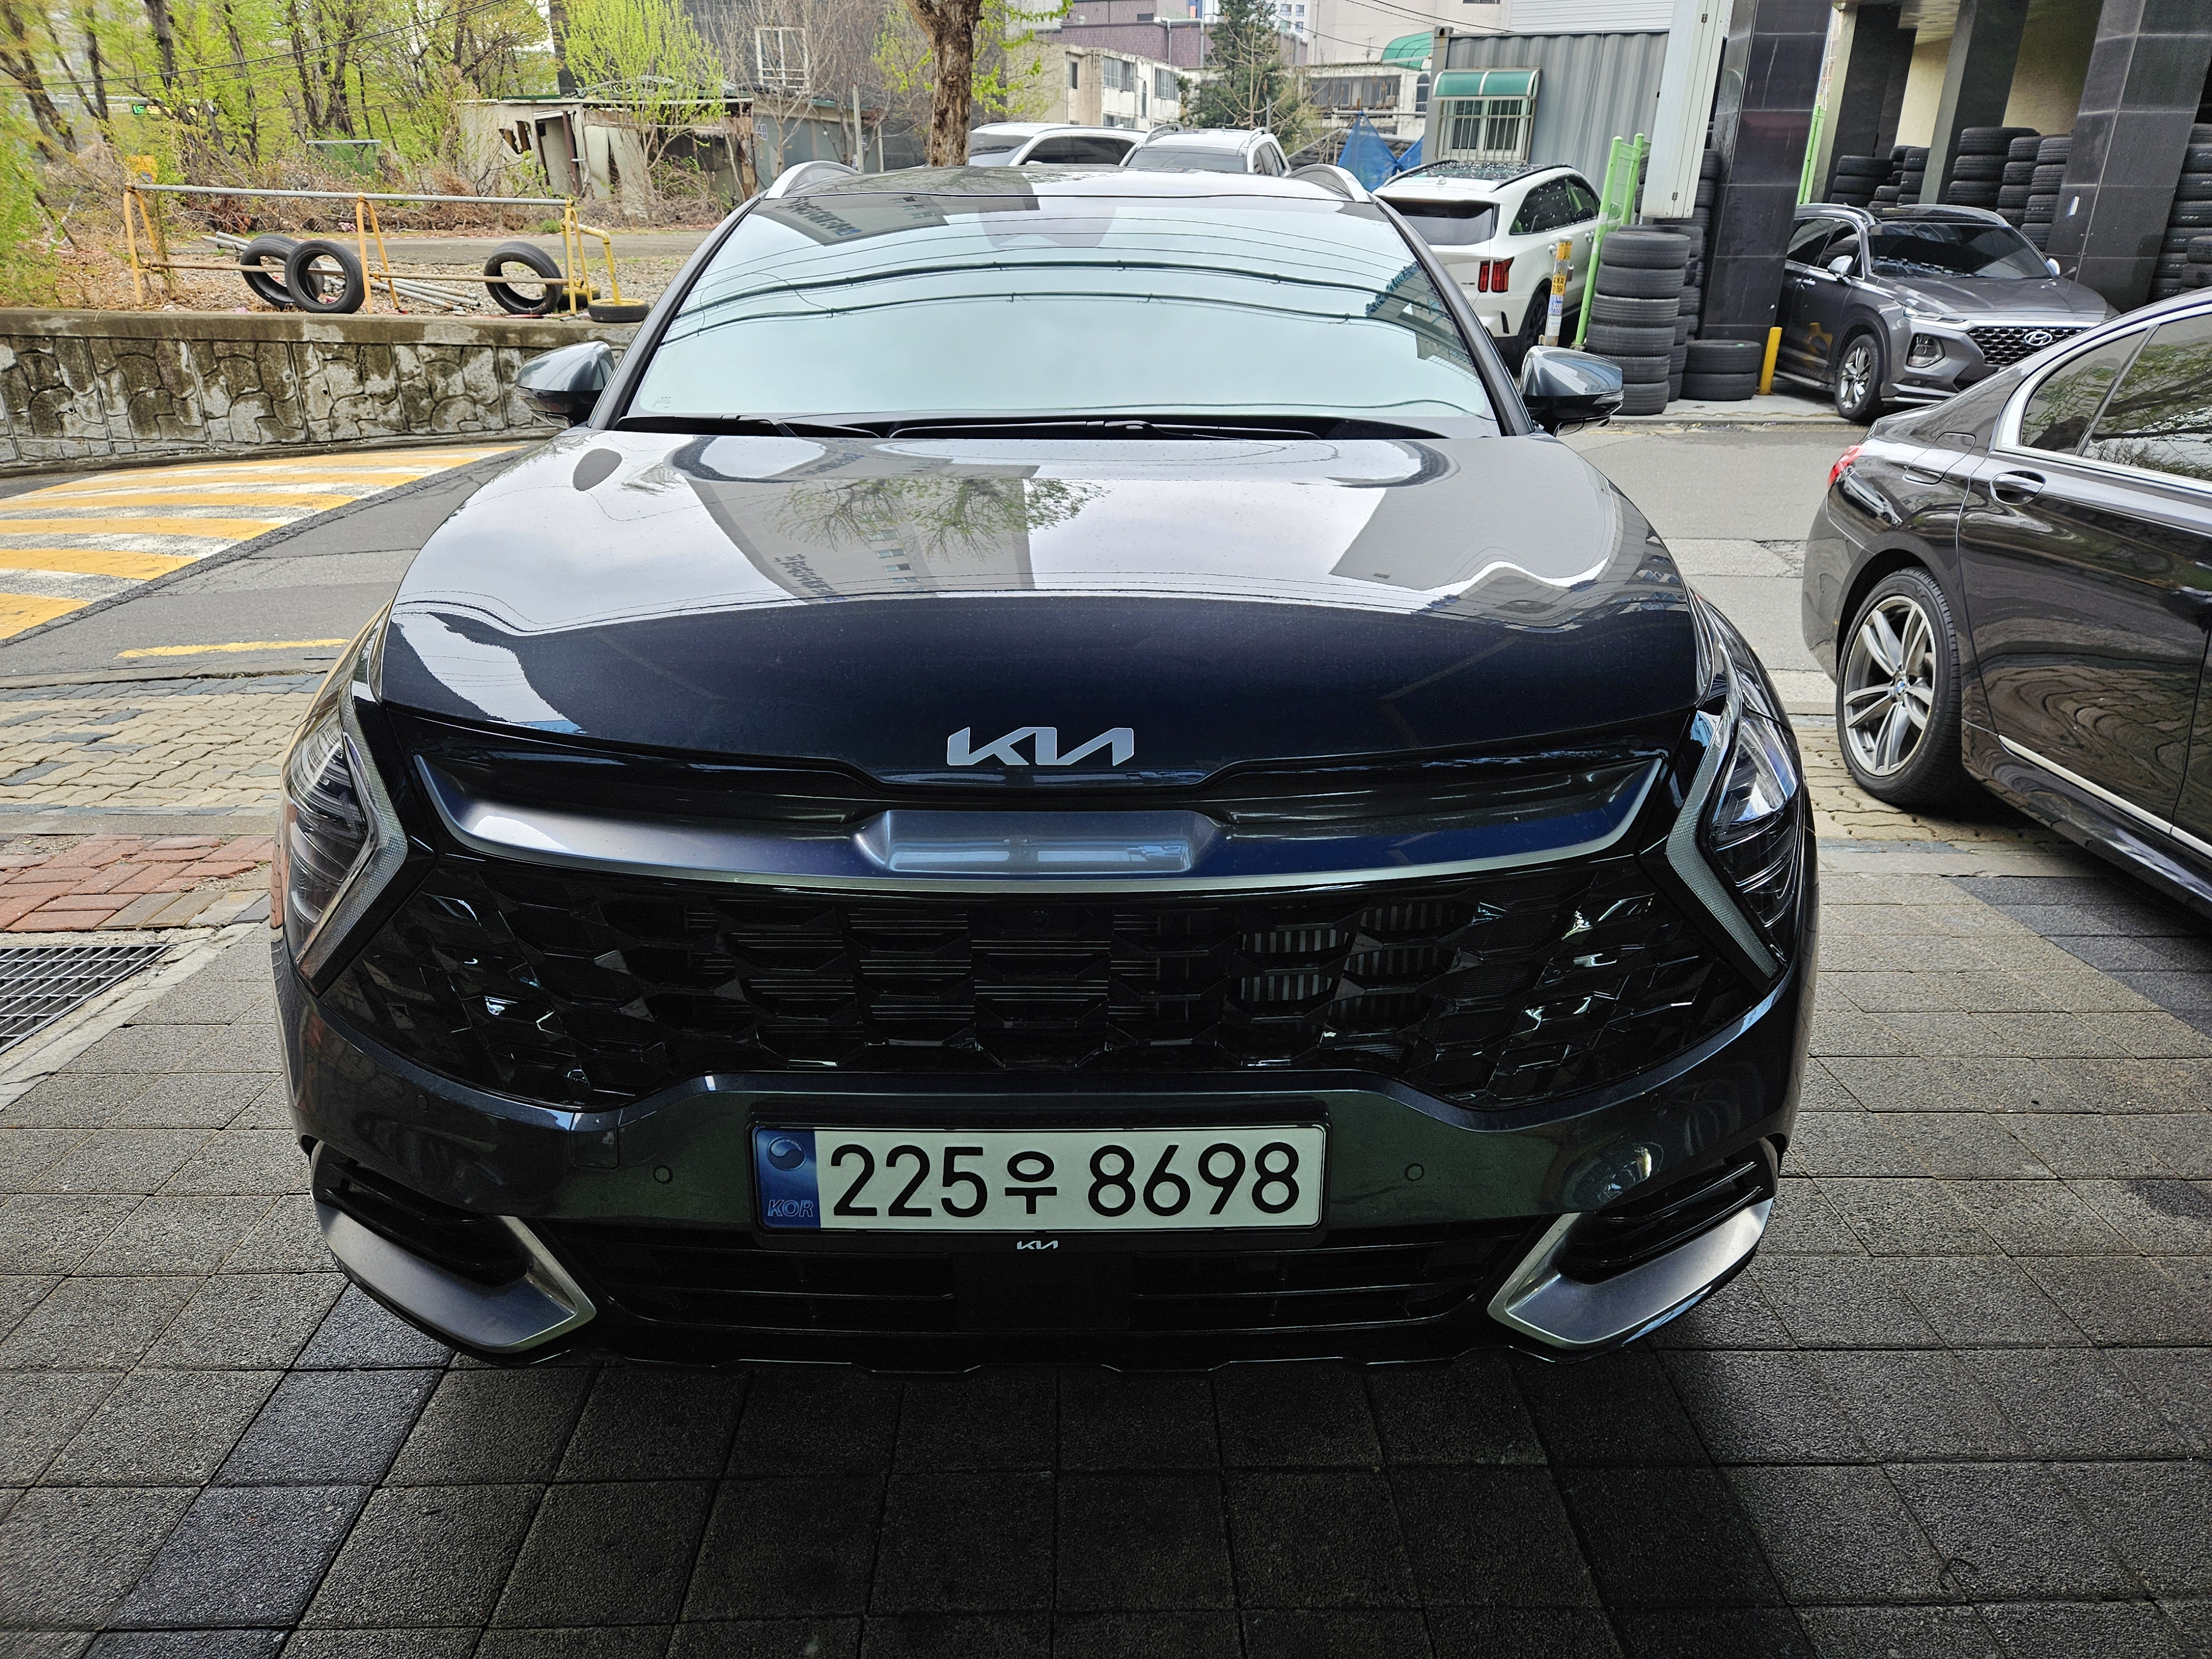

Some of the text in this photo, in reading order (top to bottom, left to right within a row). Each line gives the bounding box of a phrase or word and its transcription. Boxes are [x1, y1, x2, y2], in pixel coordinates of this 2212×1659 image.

[947, 727, 1134, 766] KIA
[831, 1141, 1300, 1218] 225우 8698
[768, 1199, 814, 1217] KOR
